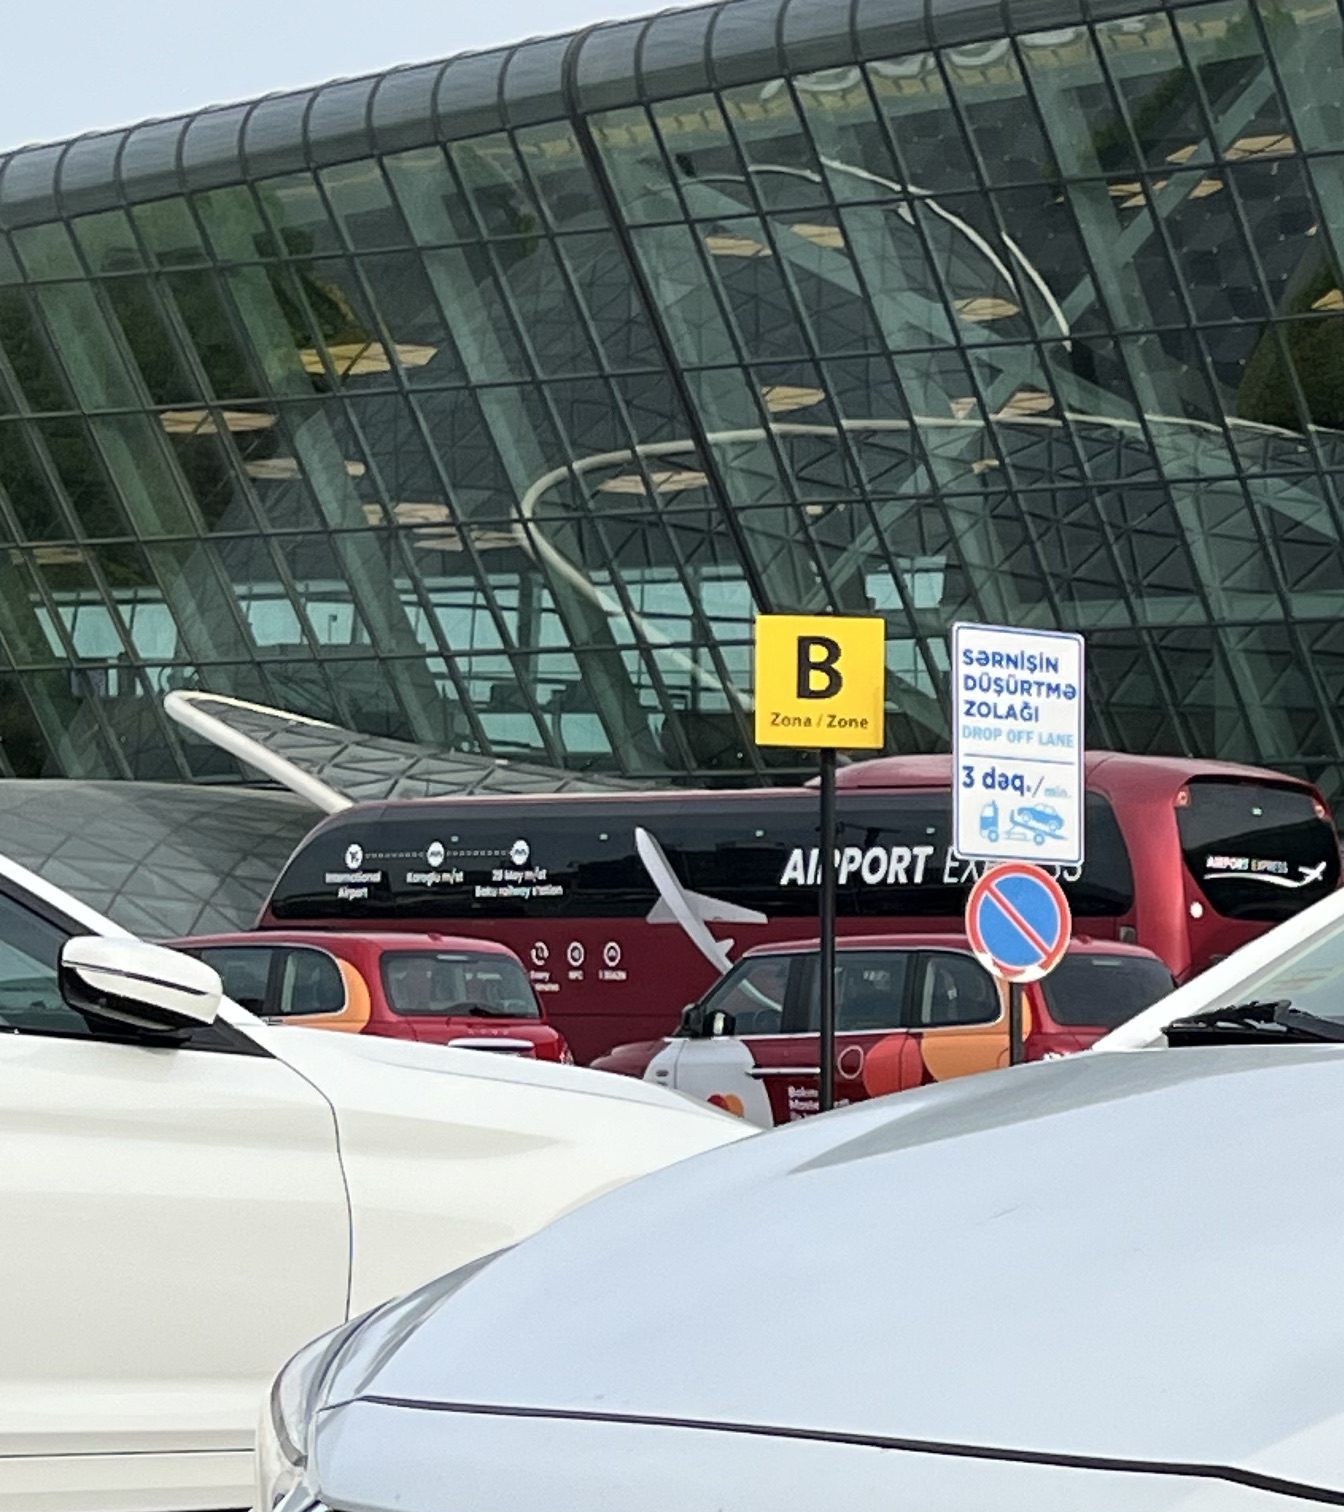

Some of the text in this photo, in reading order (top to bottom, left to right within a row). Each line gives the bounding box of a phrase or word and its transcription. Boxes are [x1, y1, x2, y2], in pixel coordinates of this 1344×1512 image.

[797, 635, 843, 699] B
[962, 648, 1059, 674] SƏRNİŞİN
[963, 672, 1077, 700] DÜŞÜRTMƏ
[770, 712, 812, 727] Zona
[826, 715, 869, 729] Zone
[963, 700, 1039, 722] ZOLAĞI
[962, 725, 1074, 748] DROP OFF LANE
[962, 765, 974, 788] 3
